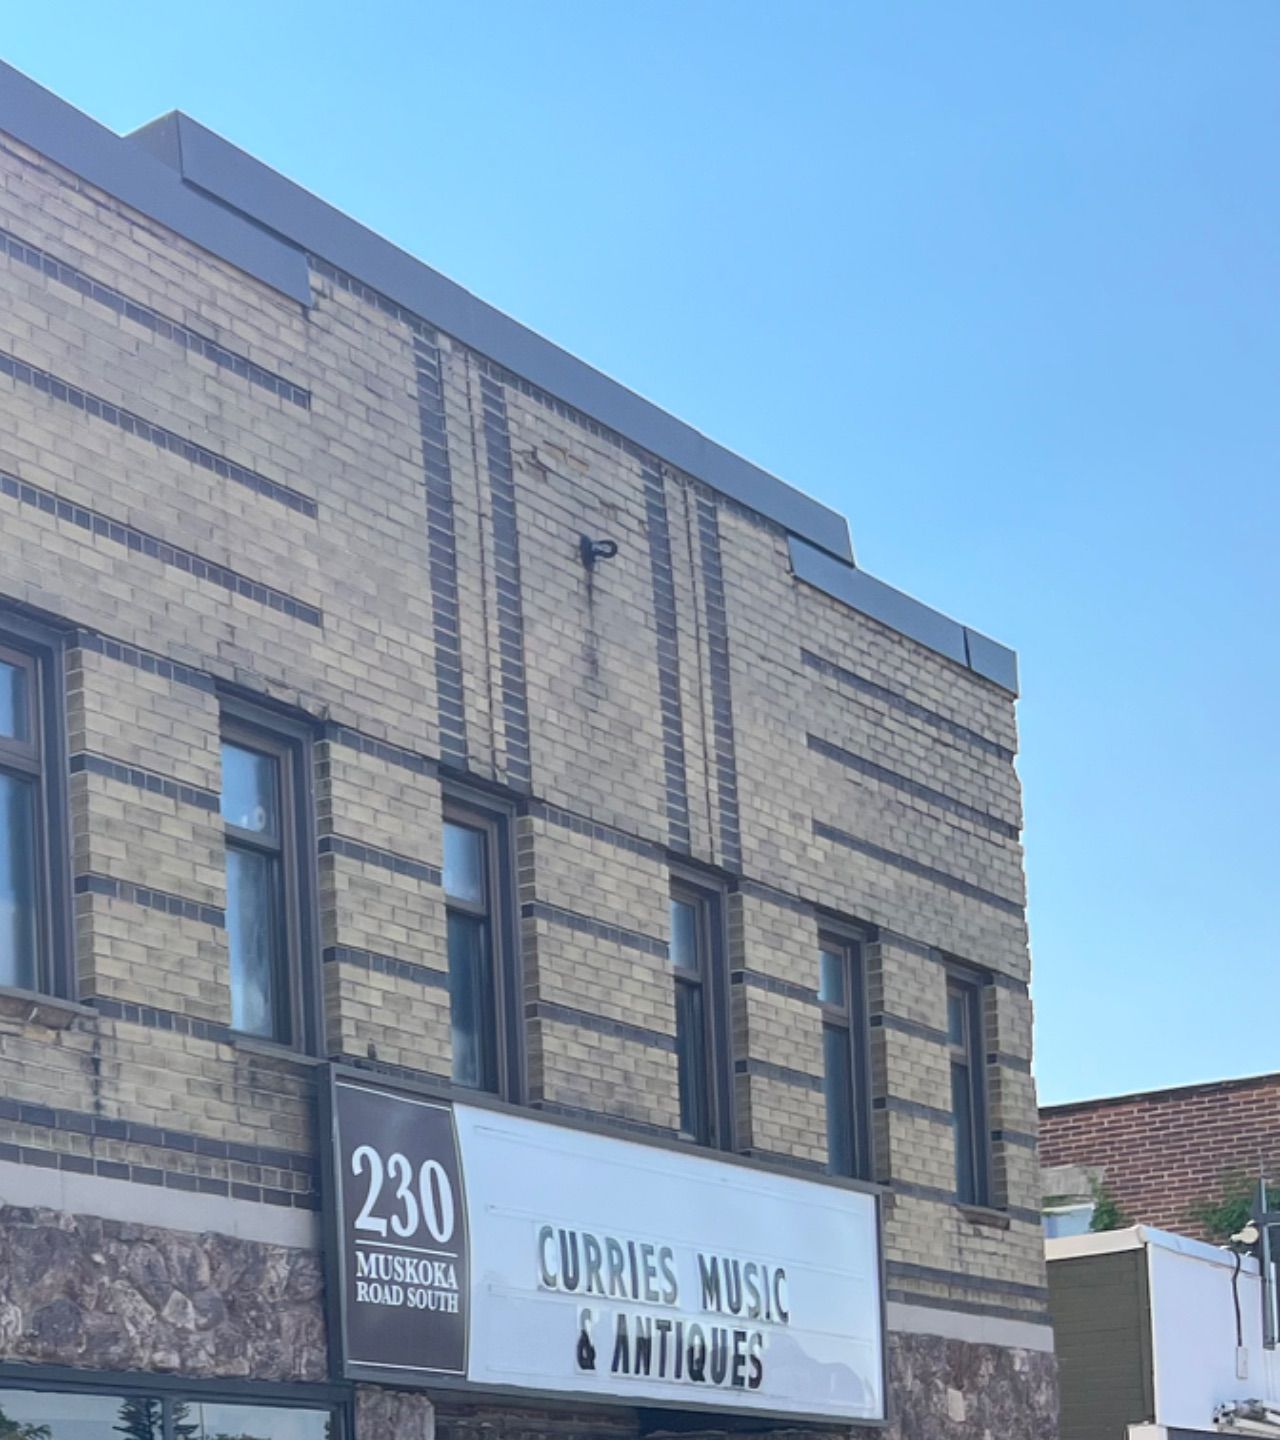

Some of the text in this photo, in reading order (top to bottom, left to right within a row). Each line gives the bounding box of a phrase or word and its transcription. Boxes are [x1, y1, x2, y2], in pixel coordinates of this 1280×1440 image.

[352, 1145, 454, 1243] 230
[355, 1251, 459, 1290] MUSKOKA
[356, 1281, 459, 1313] ROAD SOUTH
[538, 1225, 789, 1322] CURRIES MUSIC
[576, 1308, 763, 1389] & ANTIQUES
